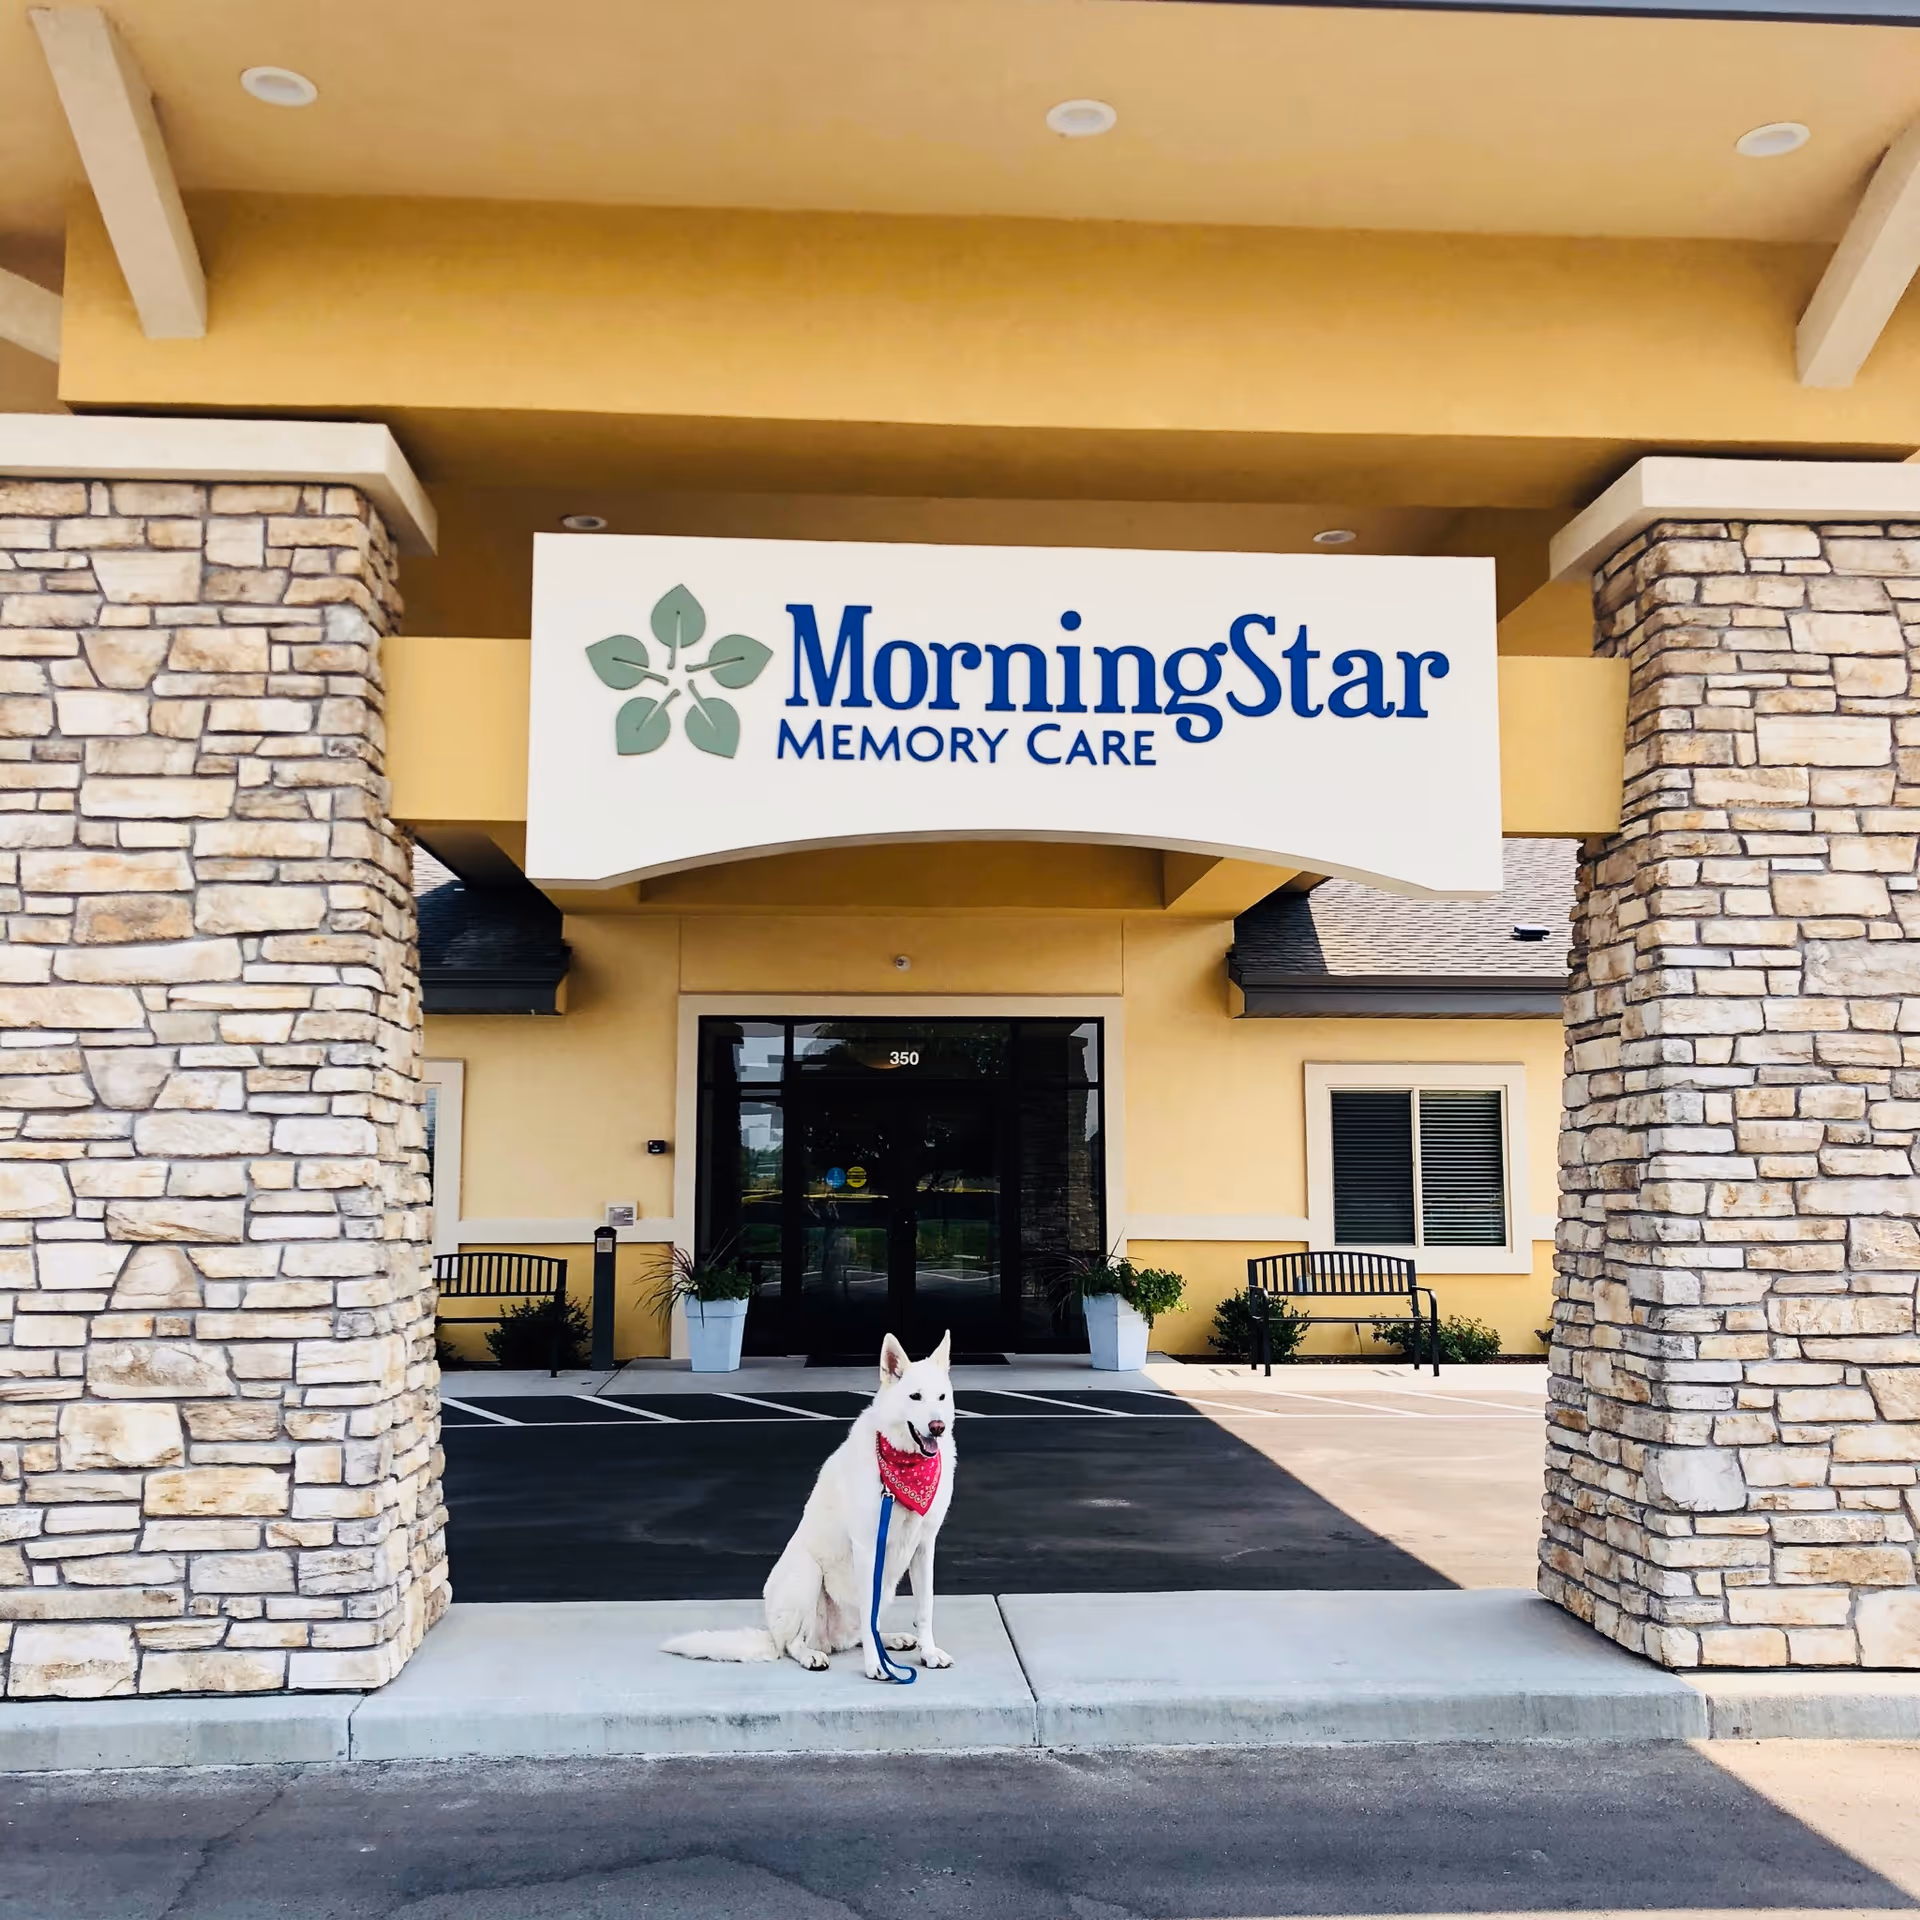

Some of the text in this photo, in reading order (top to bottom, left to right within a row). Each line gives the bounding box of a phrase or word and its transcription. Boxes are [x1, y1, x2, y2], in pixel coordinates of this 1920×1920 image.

[784, 603, 1450, 744] MorningStar
[777, 718, 1156, 766] MEMORY CARE
[889, 1051, 920, 1066] 350
